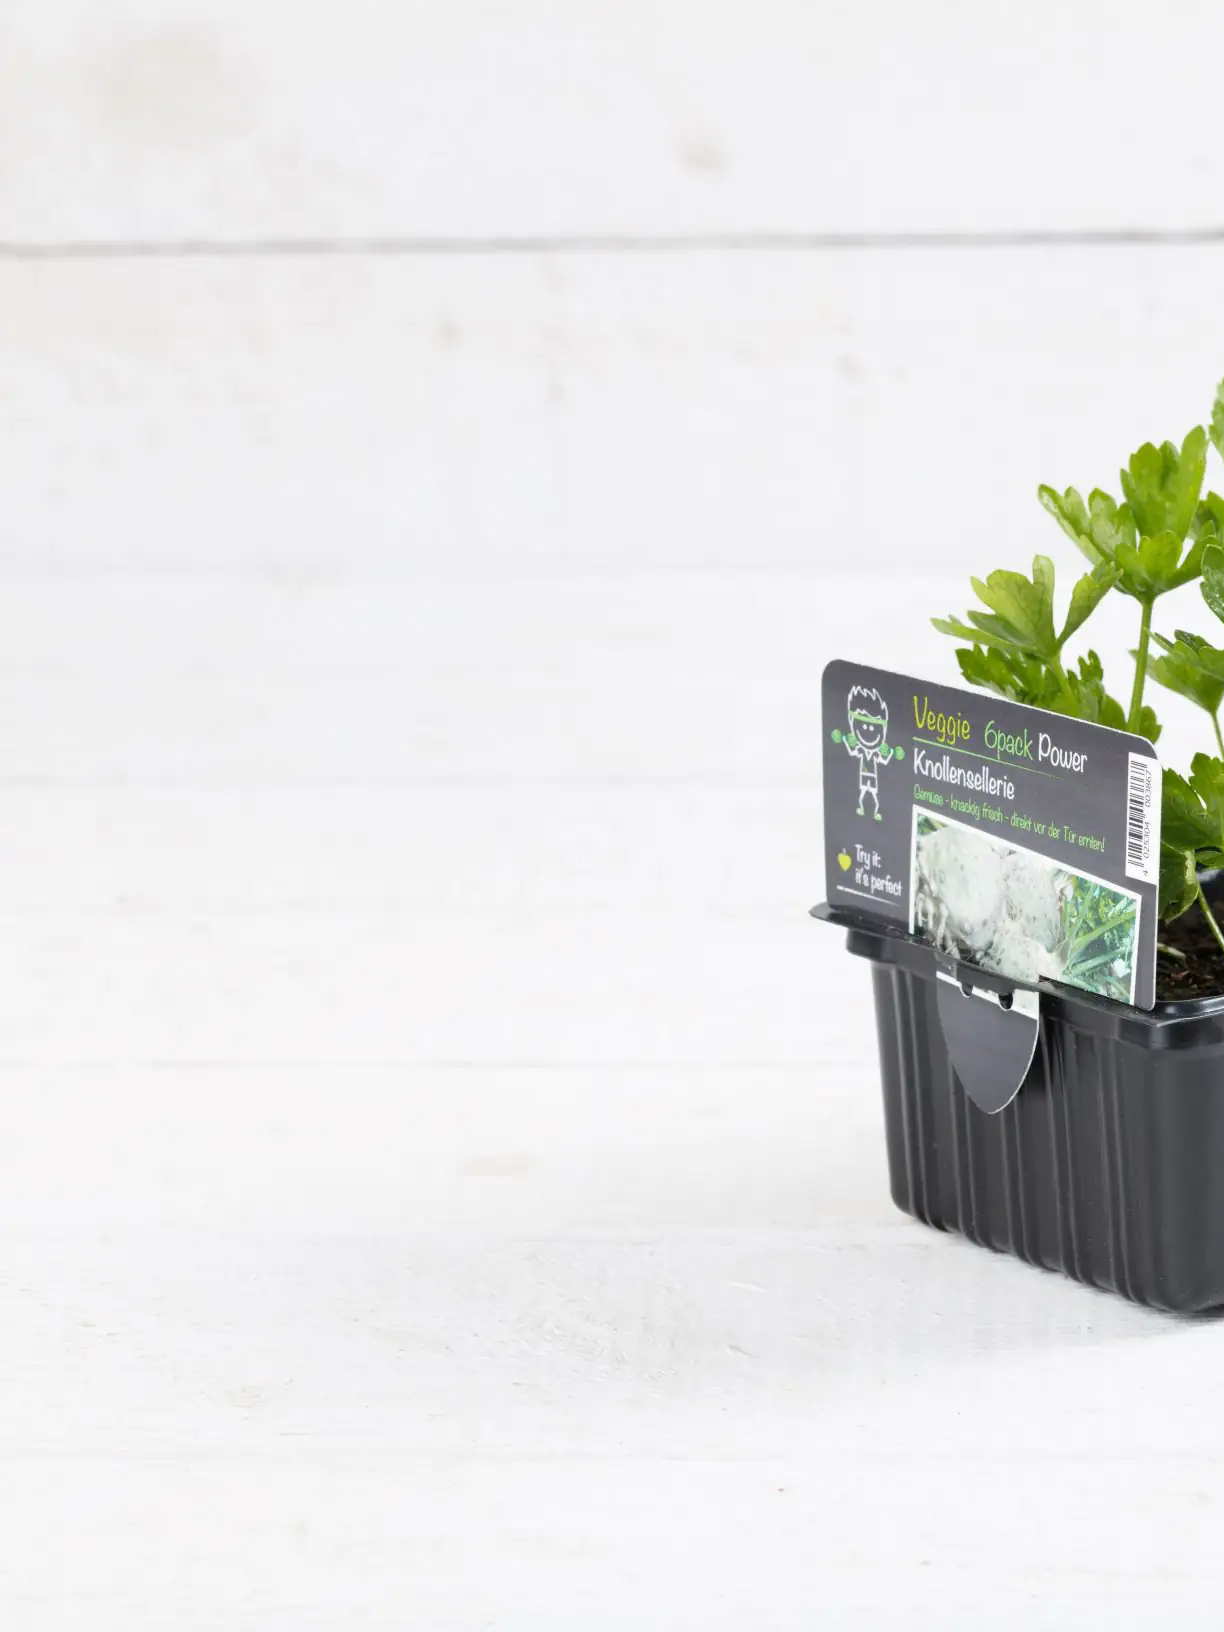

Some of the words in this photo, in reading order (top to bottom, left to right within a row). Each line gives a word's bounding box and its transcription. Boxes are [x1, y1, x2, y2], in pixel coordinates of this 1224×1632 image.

[913, 695, 971, 745] Veggie
[984, 720, 1033, 761] 6pack
[1038, 732, 1088, 774] Power
[913, 747, 1015, 800] Knollensellerie
[1144, 769, 1152, 808] 003867
[950, 793, 980, 821] knackig
[982, 802, 1004, 824] frisch
[1010, 811, 1032, 832] direkt
[1033, 821, 1047, 835] vor
[1047, 821, 1060, 840] der
[1078, 835, 1105, 853] ernten!
[1143, 821, 1151, 859] 025304
[854, 843, 871, 870] Try
[872, 850, 882, 868] it:
[855, 867, 869, 887] it's
[870, 874, 903, 897] perfect
